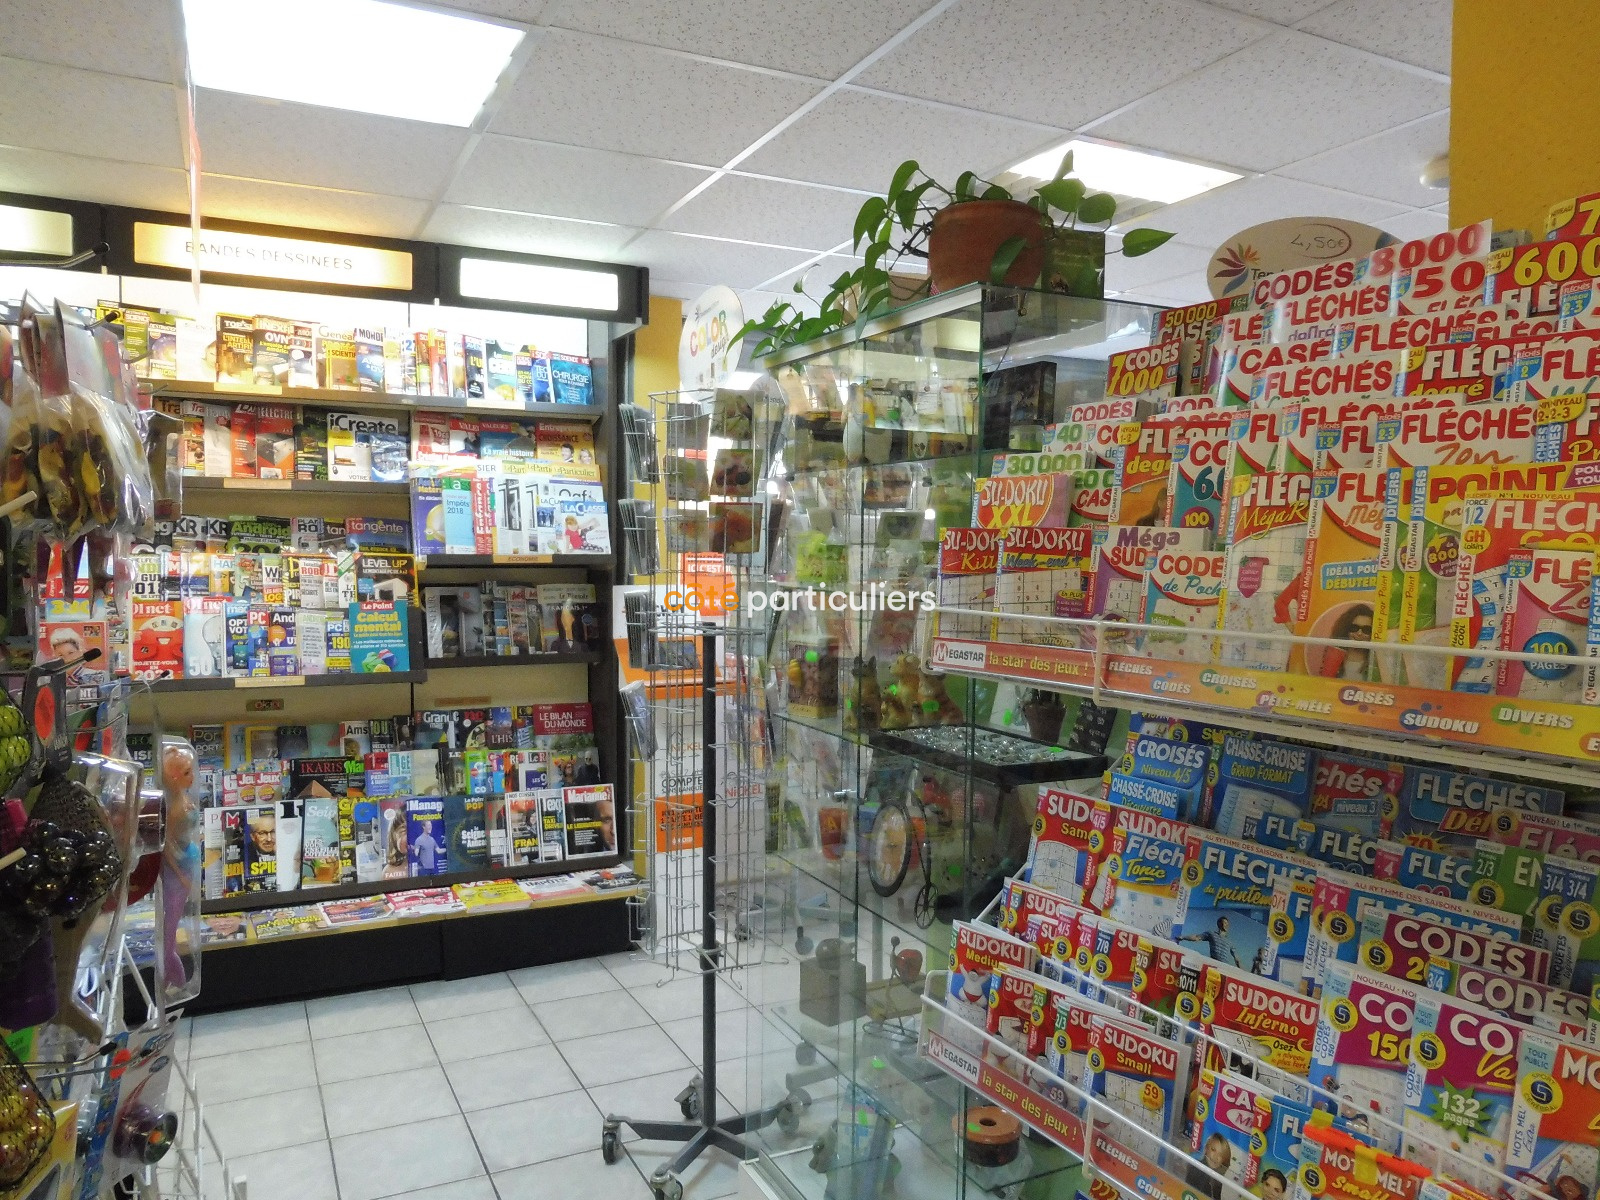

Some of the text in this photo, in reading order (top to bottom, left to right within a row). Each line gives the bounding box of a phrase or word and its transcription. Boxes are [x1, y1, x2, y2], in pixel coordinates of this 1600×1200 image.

[1255, 262, 1354, 305] CODÉS
[1412, 261, 1485, 299] 50
[1283, 285, 1389, 326] FLÉCHÉS
[690, 310, 728, 356] COLOR
[1125, 342, 1179, 370] CODÉS
[1264, 360, 1393, 400] FLÉCHÉS
[1072, 401, 1134, 422] CODÉS
[330, 414, 397, 434] iCreate
[1057, 424, 1082, 442] 40
[508, 449, 534, 457] histoire
[1007, 454, 1082, 475] 30 000
[980, 479, 1048, 507] SU-DOKU
[1389, 471, 1400, 517] DIVERS
[1415, 470, 1427, 517] DIVERS
[447, 506, 464, 515] 2018
[987, 503, 1033, 529] XXL
[1185, 512, 1210, 526] 100
[1007, 528, 1085, 550] SU-DOKU
[1117, 527, 1180, 550] Méga
[1465, 531, 1485, 543] GH
[362, 559, 391, 567] LEVEL
[1455, 553, 1473, 616] FLÉCHÉS
[250, 612, 266, 625] PC
[357, 612, 399, 622] Calcul
[1401, 618, 1411, 642] Point
[1406, 575, 1415, 598] Point
[328, 623, 342, 631] PC
[354, 622, 401, 631] mental
[989, 653, 999, 665] la
[1003, 655, 1026, 668] star
[1030, 656, 1050, 671] des
[1054, 658, 1079, 676] jeux
[550, 712, 573, 720] BILAN
[556, 720, 587, 728] MONDE
[1403, 713, 1479, 735] SUDOKU
[1498, 707, 1574, 729] DIVERS
[1137, 739, 1205, 769] CROISÉS
[466, 802, 483, 811] POP
[1242, 842, 1254, 852] DES
[1255, 846, 1284, 859] SAISONS
[1476, 861, 1494, 877] 2/3
[1544, 873, 1564, 893] 3/4
[1567, 879, 1588, 899] 3/4
[1370, 886, 1405, 900] RYTHME
[1406, 893, 1423, 903] DES
[1425, 899, 1462, 913] SAISONS
[1472, 909, 1510, 924] NIVEAU
[1026, 929, 1037, 941] 5/6
[1058, 922, 1070, 936] 4/5
[960, 930, 1022, 962] SUDOKU
[1079, 934, 1091, 947] 4/5
[1096, 938, 1110, 952] 7/8
[1179, 974, 1198, 992] 10/11
[1034, 993, 1043, 1006] 2/3
[1227, 983, 1317, 1026] SUDOKU
[1235, 1009, 1299, 1036] Inferno
[1104, 1028, 1175, 1071] SUDOKU
[1273, 1041, 1293, 1052] Osez
[1117, 1053, 1152, 1074] Small
[1144, 1085, 1159, 1098] 59
[983, 1070, 992, 1087] la
[995, 1082, 1018, 1103] star
[1021, 1096, 1041, 1119] des
[1043, 1109, 1069, 1136] jeux
[1438, 1091, 1481, 1119] 132
[1443, 1112, 1475, 1128] pages
